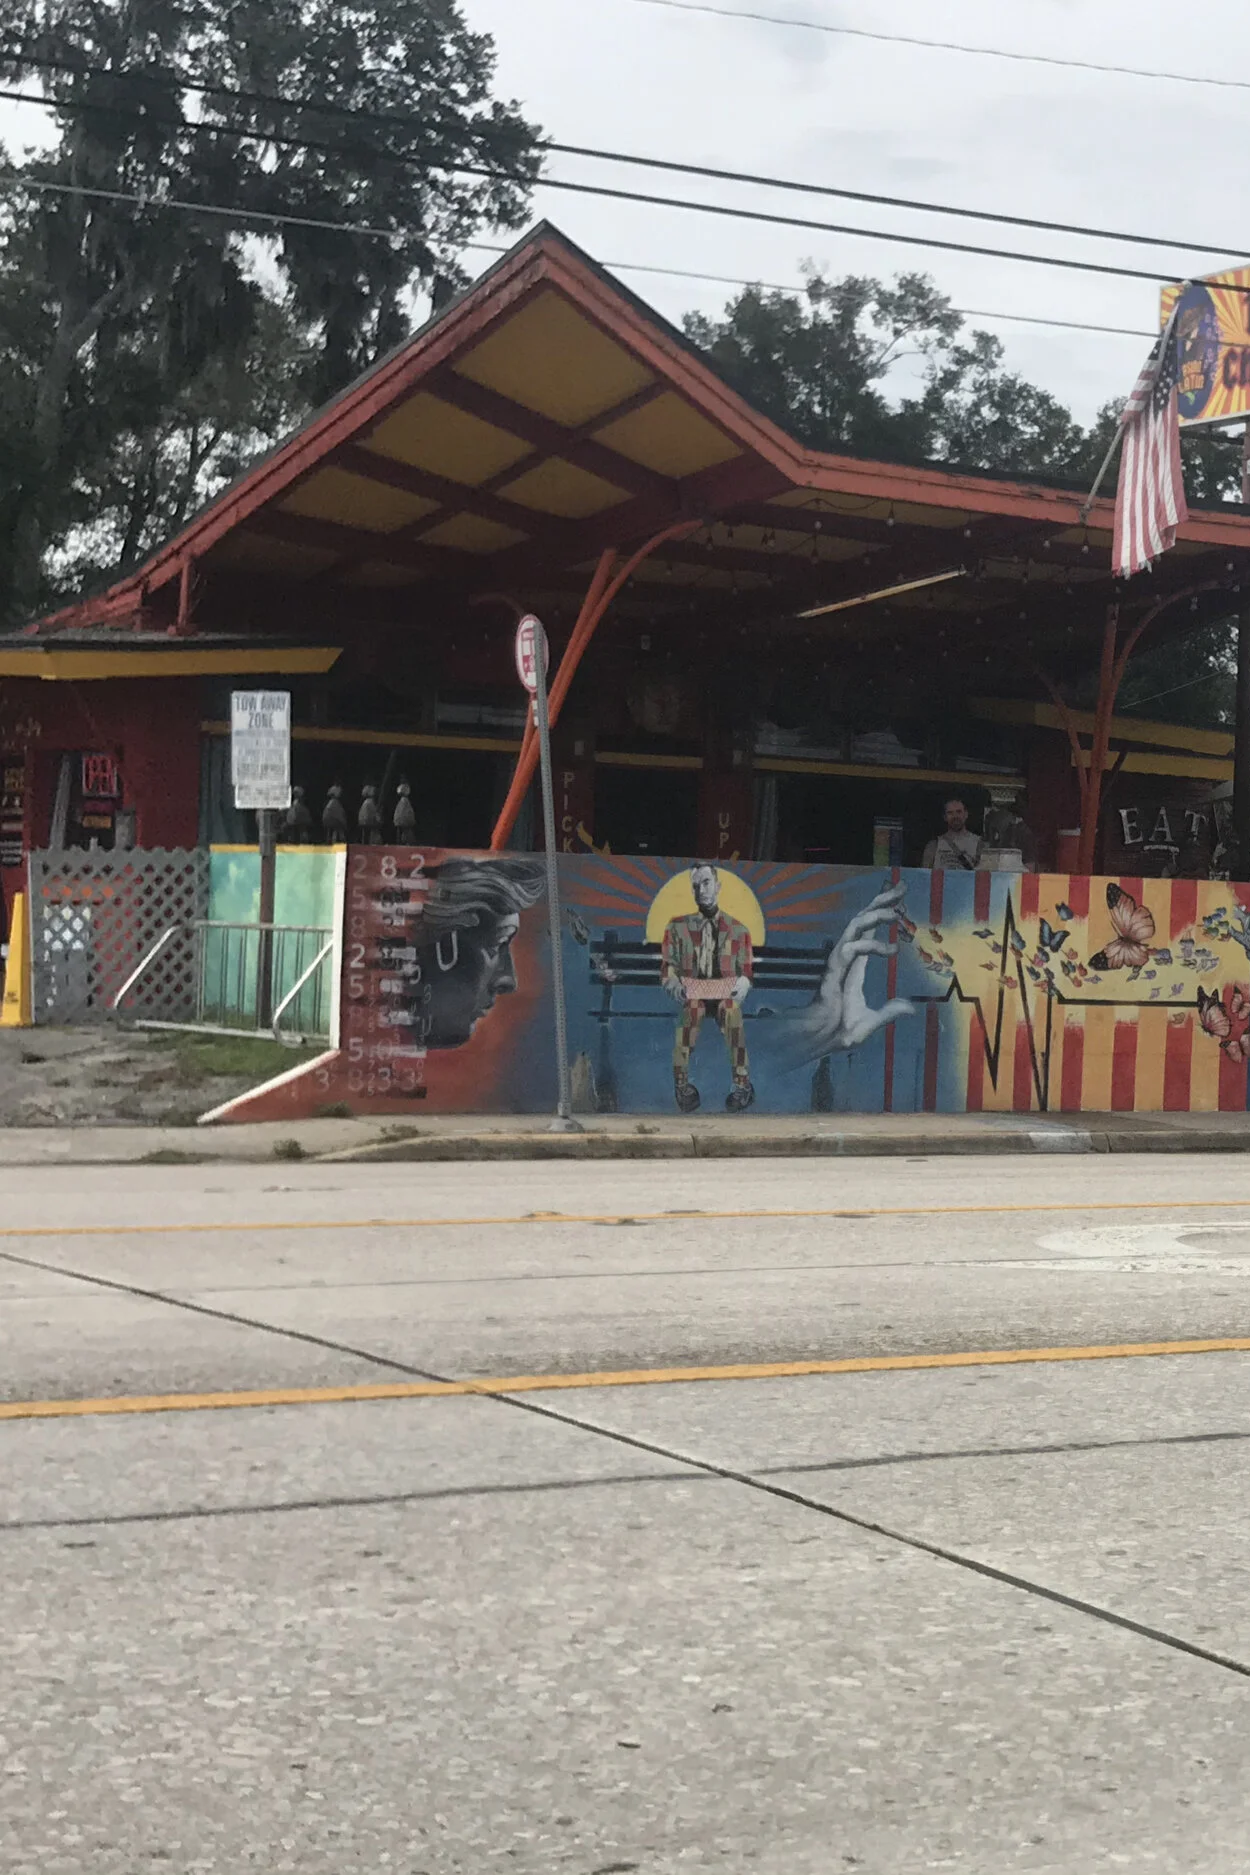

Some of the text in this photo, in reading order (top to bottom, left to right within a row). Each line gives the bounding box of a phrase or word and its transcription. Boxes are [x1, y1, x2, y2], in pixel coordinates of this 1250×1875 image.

[236, 695, 287, 711] TOW AWAY
[248, 712, 274, 729] ZONE
[718, 812, 732, 849] UP
[1118, 806, 1207, 846] EAT
[380, 855, 397, 880] 8
[410, 853, 426, 879] 2
[350, 943, 366, 968] 2
